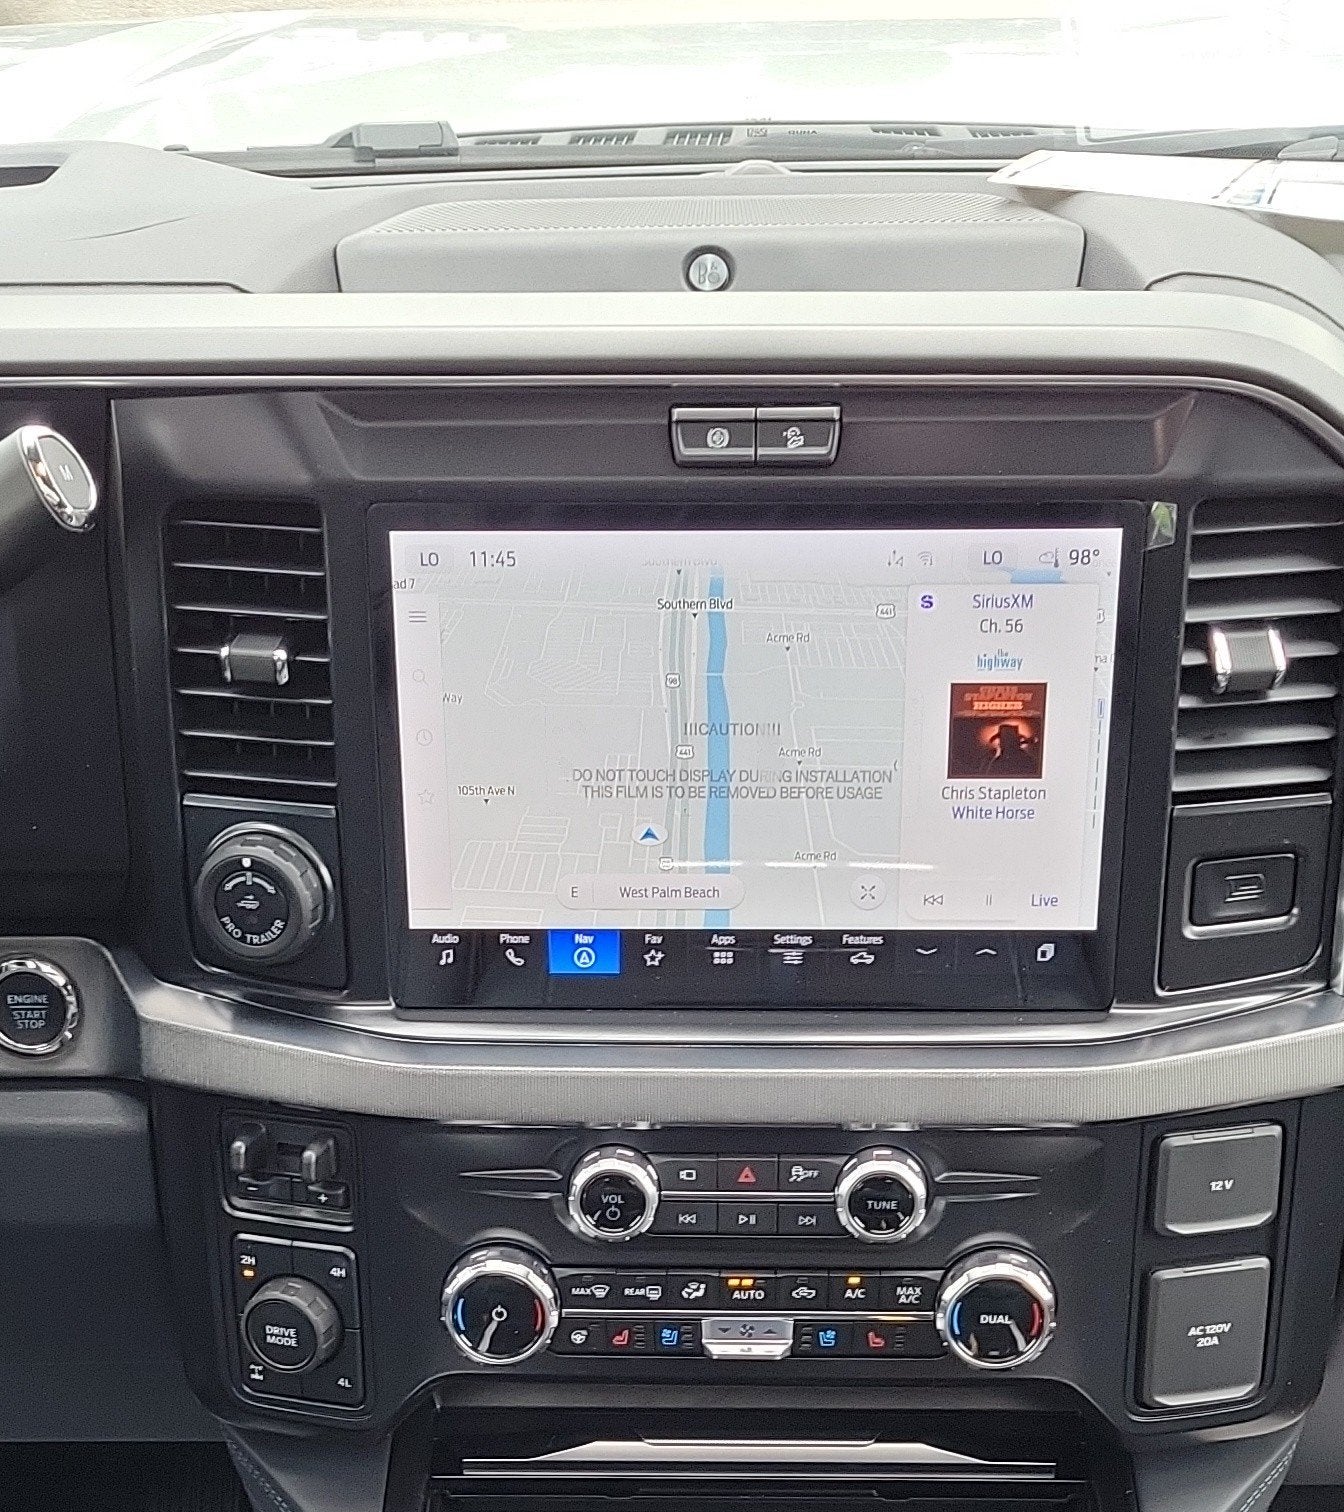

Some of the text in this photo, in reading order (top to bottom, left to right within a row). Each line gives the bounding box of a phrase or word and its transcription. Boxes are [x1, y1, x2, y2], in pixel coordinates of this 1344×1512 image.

[420, 552, 439, 567] LO
[469, 550, 516, 567] 11:45
[983, 550, 1003, 565] LO
[1068, 549, 1100, 566] 98°
[657, 598, 733, 610] Southern Blvd
[972, 594, 1034, 609] SiriusXM
[980, 619, 1023, 633] Ch. 56
[766, 632, 810, 643] Acme Rd
[977, 653, 1023, 671] highway
[778, 746, 822, 758] Acme Rd
[573, 769, 593, 782] DO
[596, 769, 625, 782] NOT
[628, 769, 675, 782] TOUCH
[679, 769, 736, 782] DISPLAY
[796, 769, 893, 783] INSTALLATION
[458, 785, 516, 796] 105th Ave N
[583, 786, 883, 800] THIS FILM IS TO BE REMOVED BEFORE USAGE
[942, 786, 1046, 802] Chris Stapleton
[952, 806, 1035, 820] White Horse
[794, 851, 837, 862] Acme Rd
[571, 887, 578, 898] E
[619, 887, 720, 898] West Palm Beach
[1031, 894, 1059, 907] Live
[220, 916, 243, 939] PRO
[245, 919, 285, 945] TRAILER
[432, 934, 459, 944] Audio
[500, 934, 530, 944] Phone
[574, 934, 594, 944] Nav
[644, 934, 663, 944] Fav
[711, 934, 736, 946] Apps
[773, 934, 813, 946] Settings
[842, 934, 884, 945] Features
[7, 994, 49, 1005] ENGINE
[12, 1010, 46, 1020] START
[16, 1020, 46, 1029] STOP
[802, 1170, 820, 1179] OFF
[601, 1194, 625, 1205] VOL
[866, 1200, 898, 1211] TUNE
[240, 1255, 256, 1266] 2H
[329, 1267, 346, 1278] 4H
[571, 1287, 592, 1296] MAX
[624, 1288, 645, 1296] REAR
[732, 1290, 765, 1300] AUTO
[844, 1288, 866, 1299] A/C
[896, 1286, 922, 1296] MAX
[898, 1294, 920, 1304] A/C
[979, 1314, 1013, 1325] DUAL
[265, 1325, 297, 1338] DRIVE
[1187, 1325, 1205, 1337] AC
[266, 1335, 298, 1347] MODE
[1196, 1335, 1219, 1347] 20A
[337, 1378, 352, 1388] 4L
